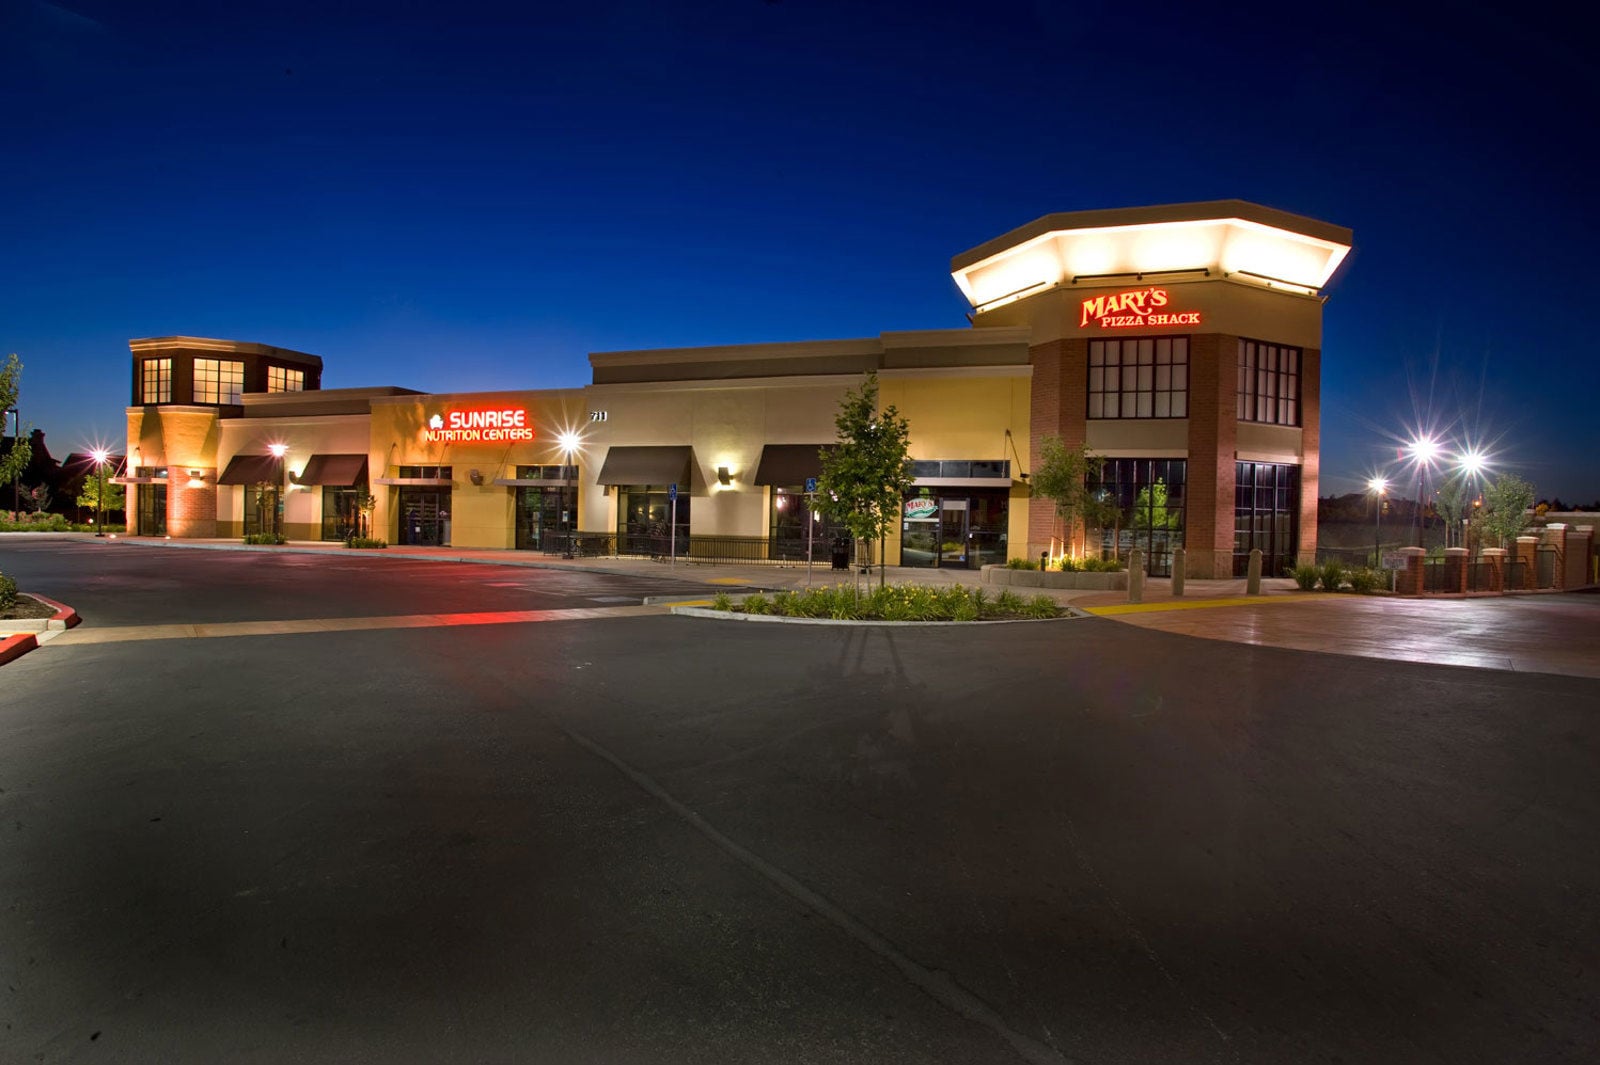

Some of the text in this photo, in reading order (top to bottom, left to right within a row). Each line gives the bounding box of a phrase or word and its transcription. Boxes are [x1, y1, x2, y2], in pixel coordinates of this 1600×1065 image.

[1080, 288, 1168, 327] MARY'S
[1101, 313, 1200, 327] PIZZA SHACK
[450, 410, 524, 427] SUNRISE
[425, 428, 533, 442] NUTRITION CENTERS
